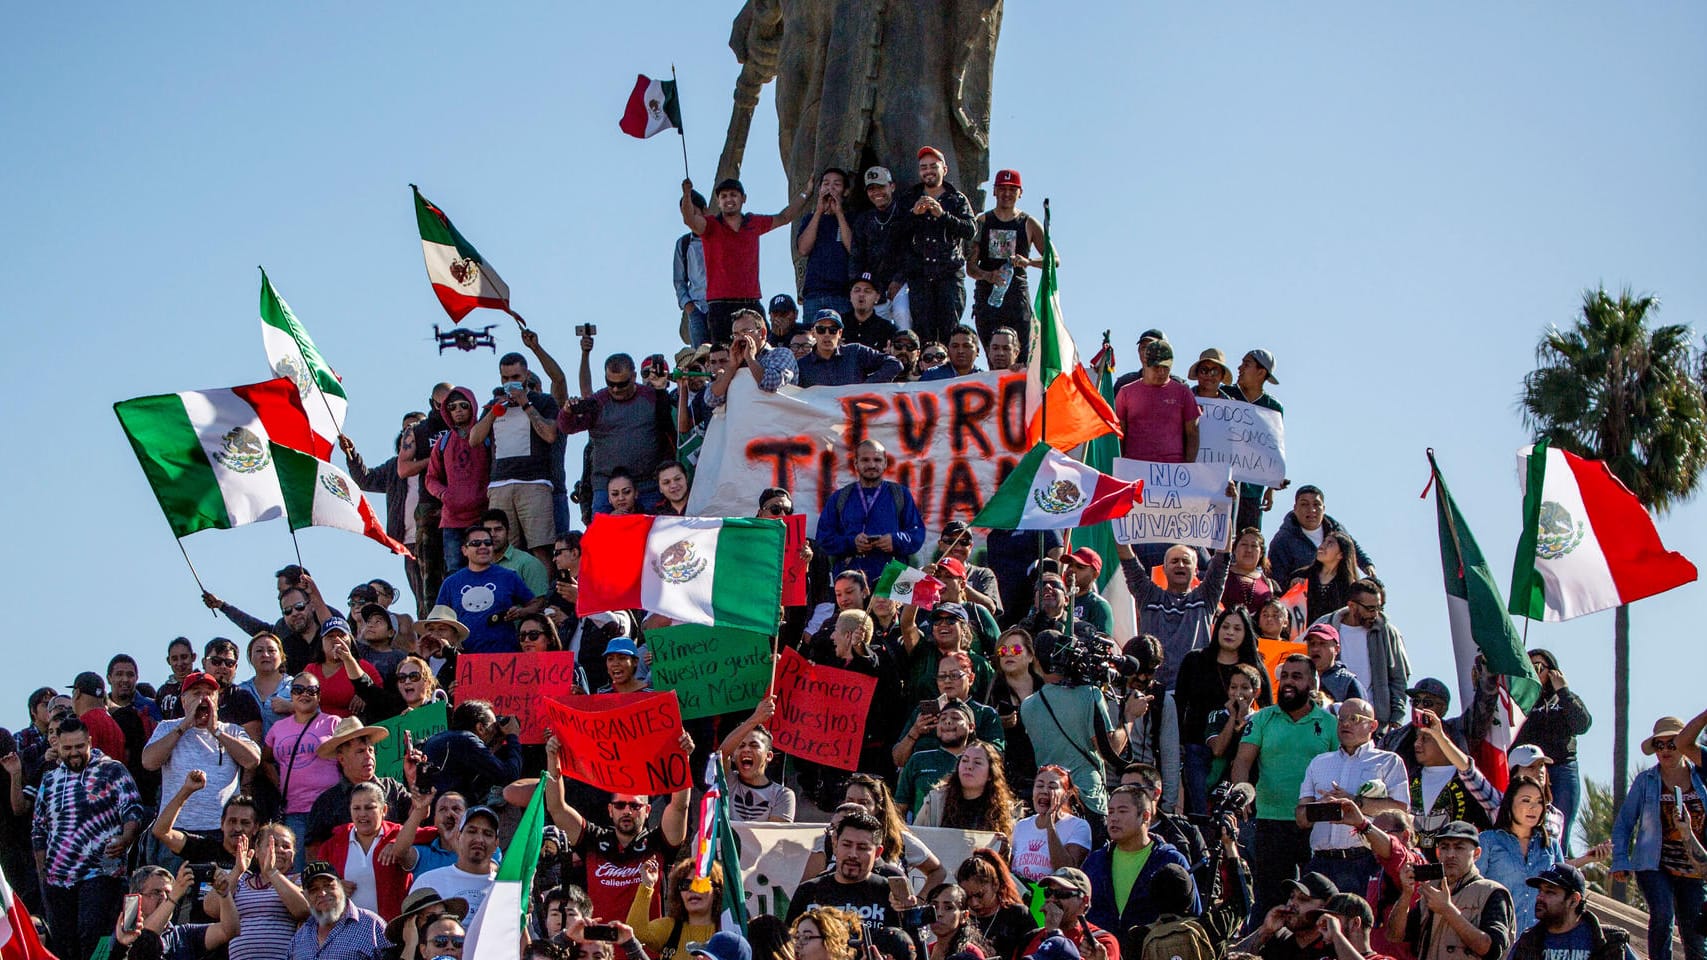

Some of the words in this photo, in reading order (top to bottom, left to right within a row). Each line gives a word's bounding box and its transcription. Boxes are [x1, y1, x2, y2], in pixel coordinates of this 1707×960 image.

[1203, 402, 1255, 426] TODOS
[1227, 427, 1279, 450] SOMOS
[1150, 463, 1191, 488] NO
[1143, 488, 1182, 509] LA
[1117, 503, 1227, 542] INVASIÓN
[648, 634, 720, 662] Primero
[461, 662, 473, 686] A
[656, 657, 718, 685] Nuestro
[724, 646, 771, 676] gente
[780, 655, 862, 704] Primero
[777, 688, 858, 735] Nuestros
[596, 740, 621, 761] SI
[768, 718, 853, 765] Pobres!
[645, 752, 687, 791] NO
